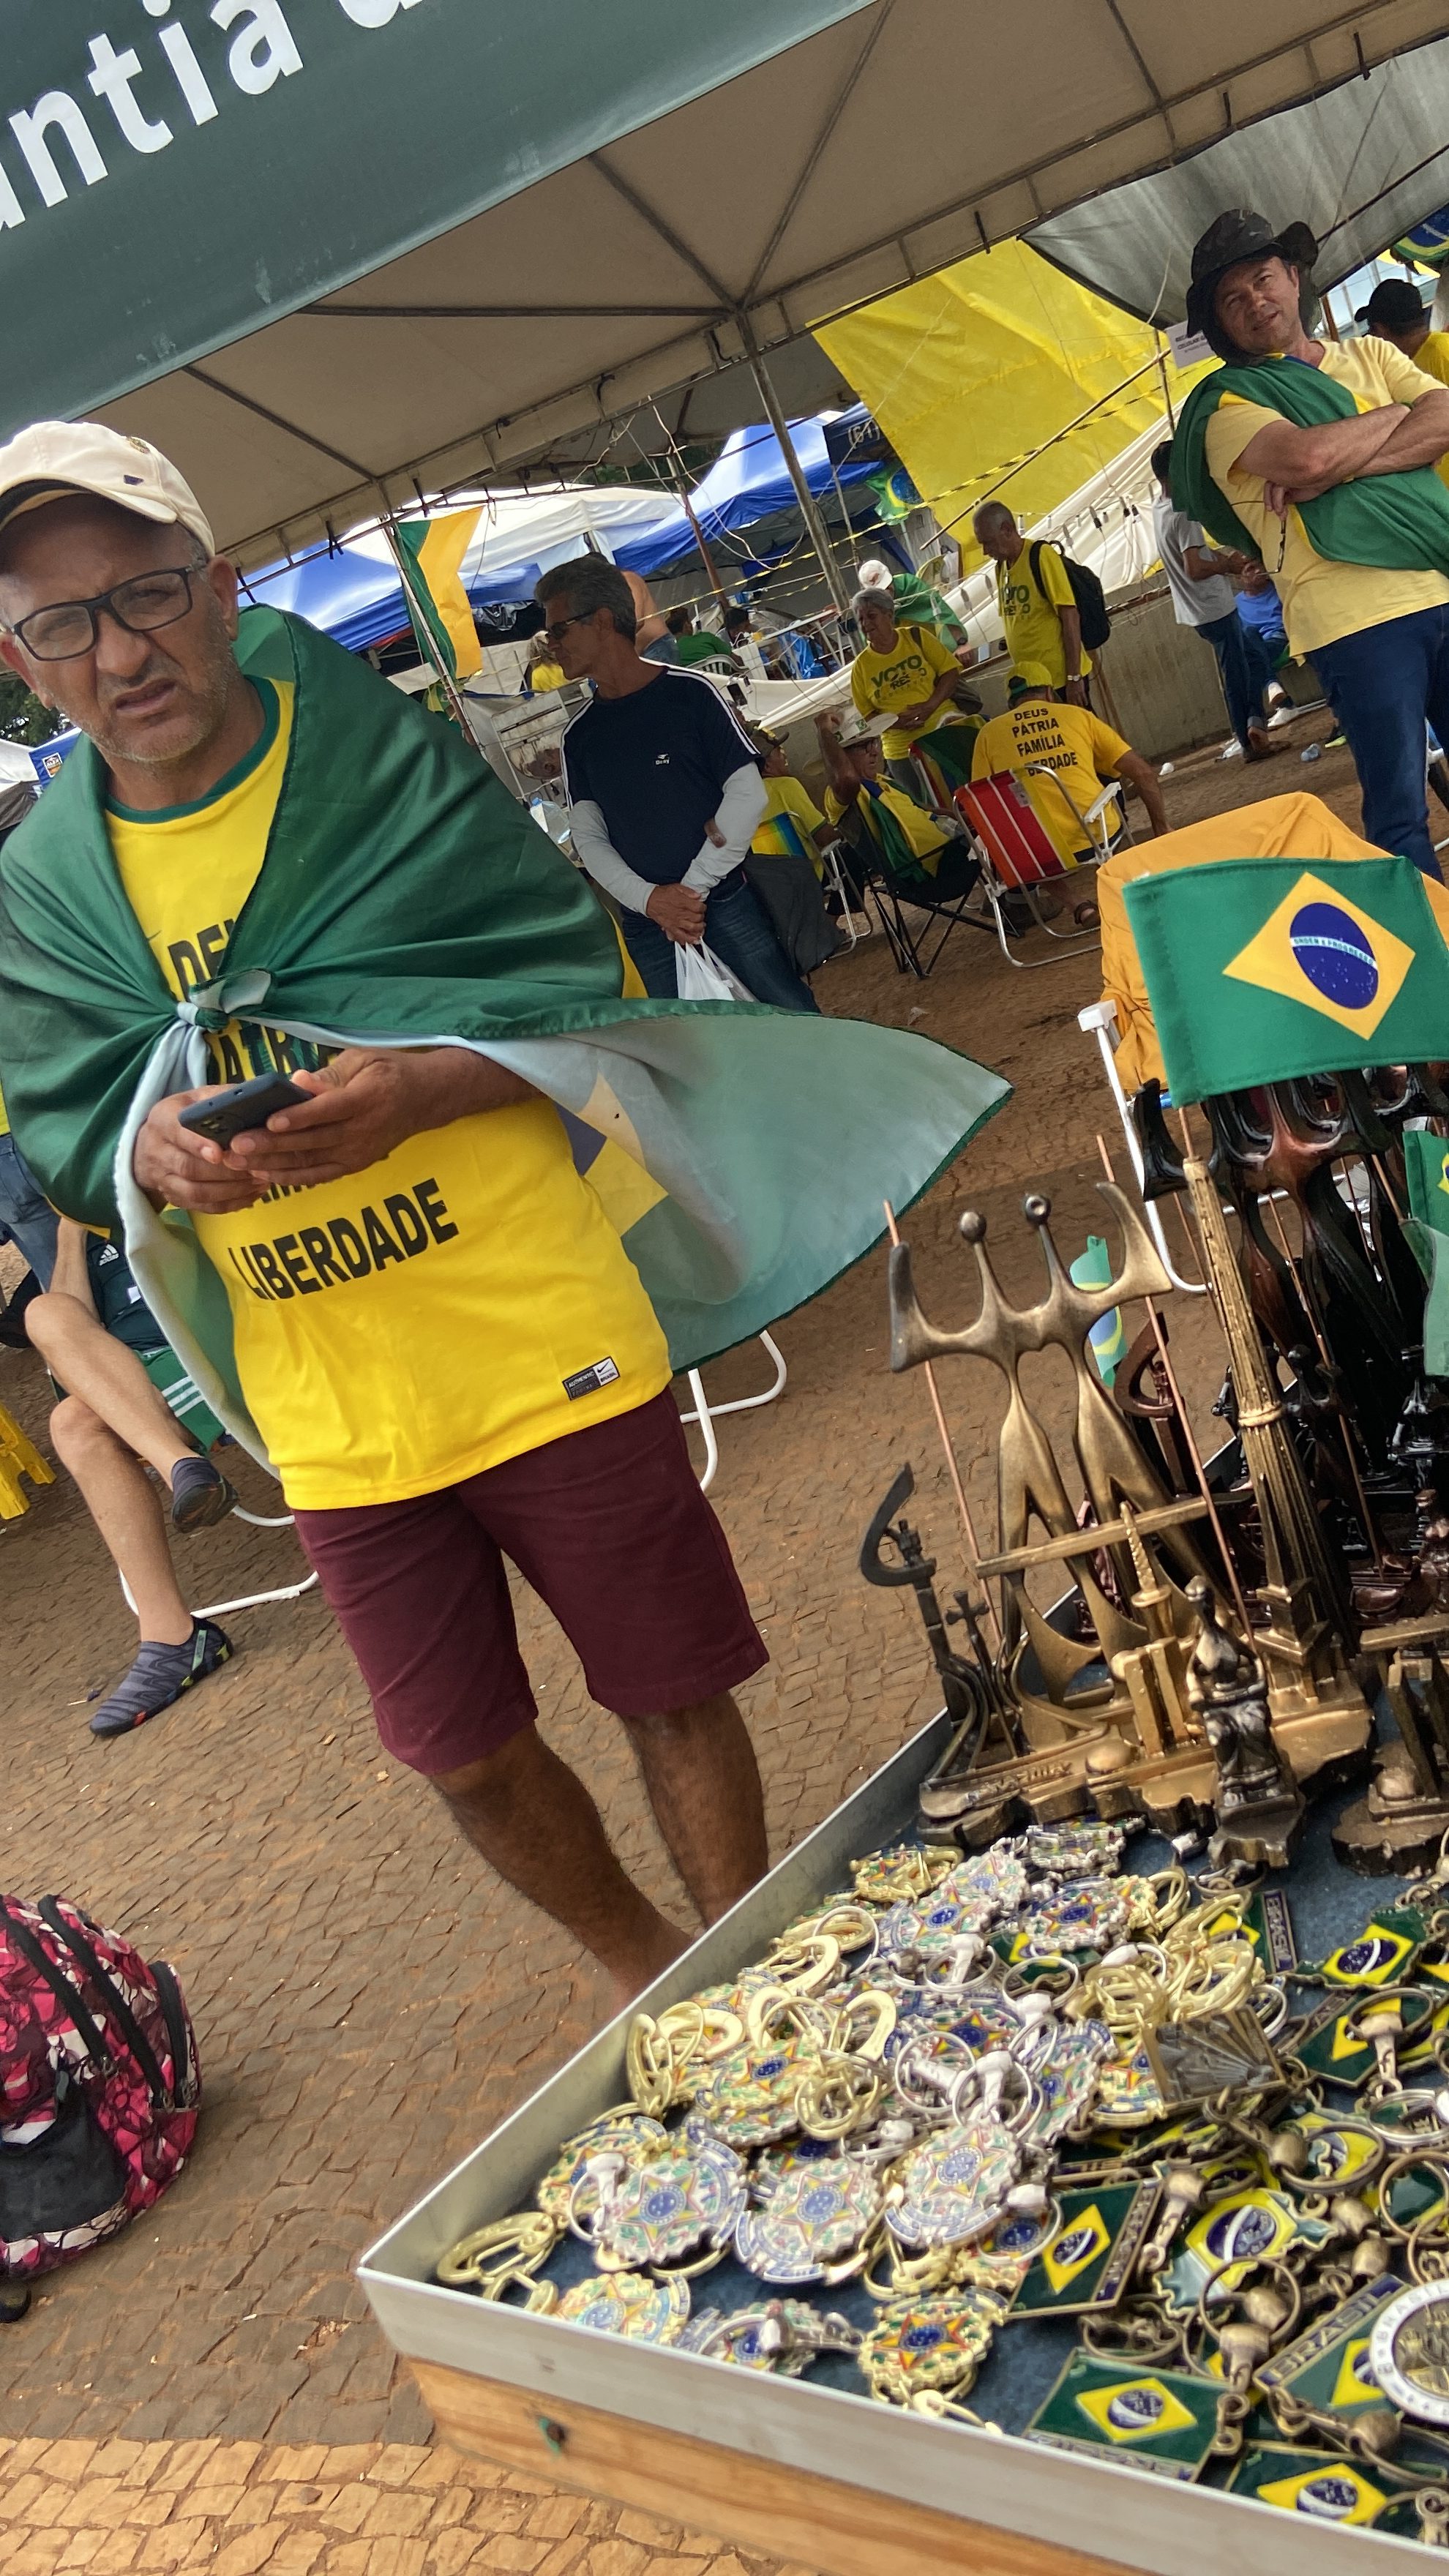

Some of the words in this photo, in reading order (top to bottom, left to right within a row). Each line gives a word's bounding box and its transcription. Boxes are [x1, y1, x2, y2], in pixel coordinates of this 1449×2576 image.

[0, 0, 304, 229] ntia
[871, 654, 922, 688] VOTO
[1011, 717, 1060, 738] PÁTRIA
[1014, 708, 1049, 722] DEUS
[1016, 734, 1066, 757] FAMÍLIA
[167, 918, 235, 1003] DE
[228, 1177, 460, 1300] LIBERDADE
[1268, 2289, 1393, 2382] BRASIL
